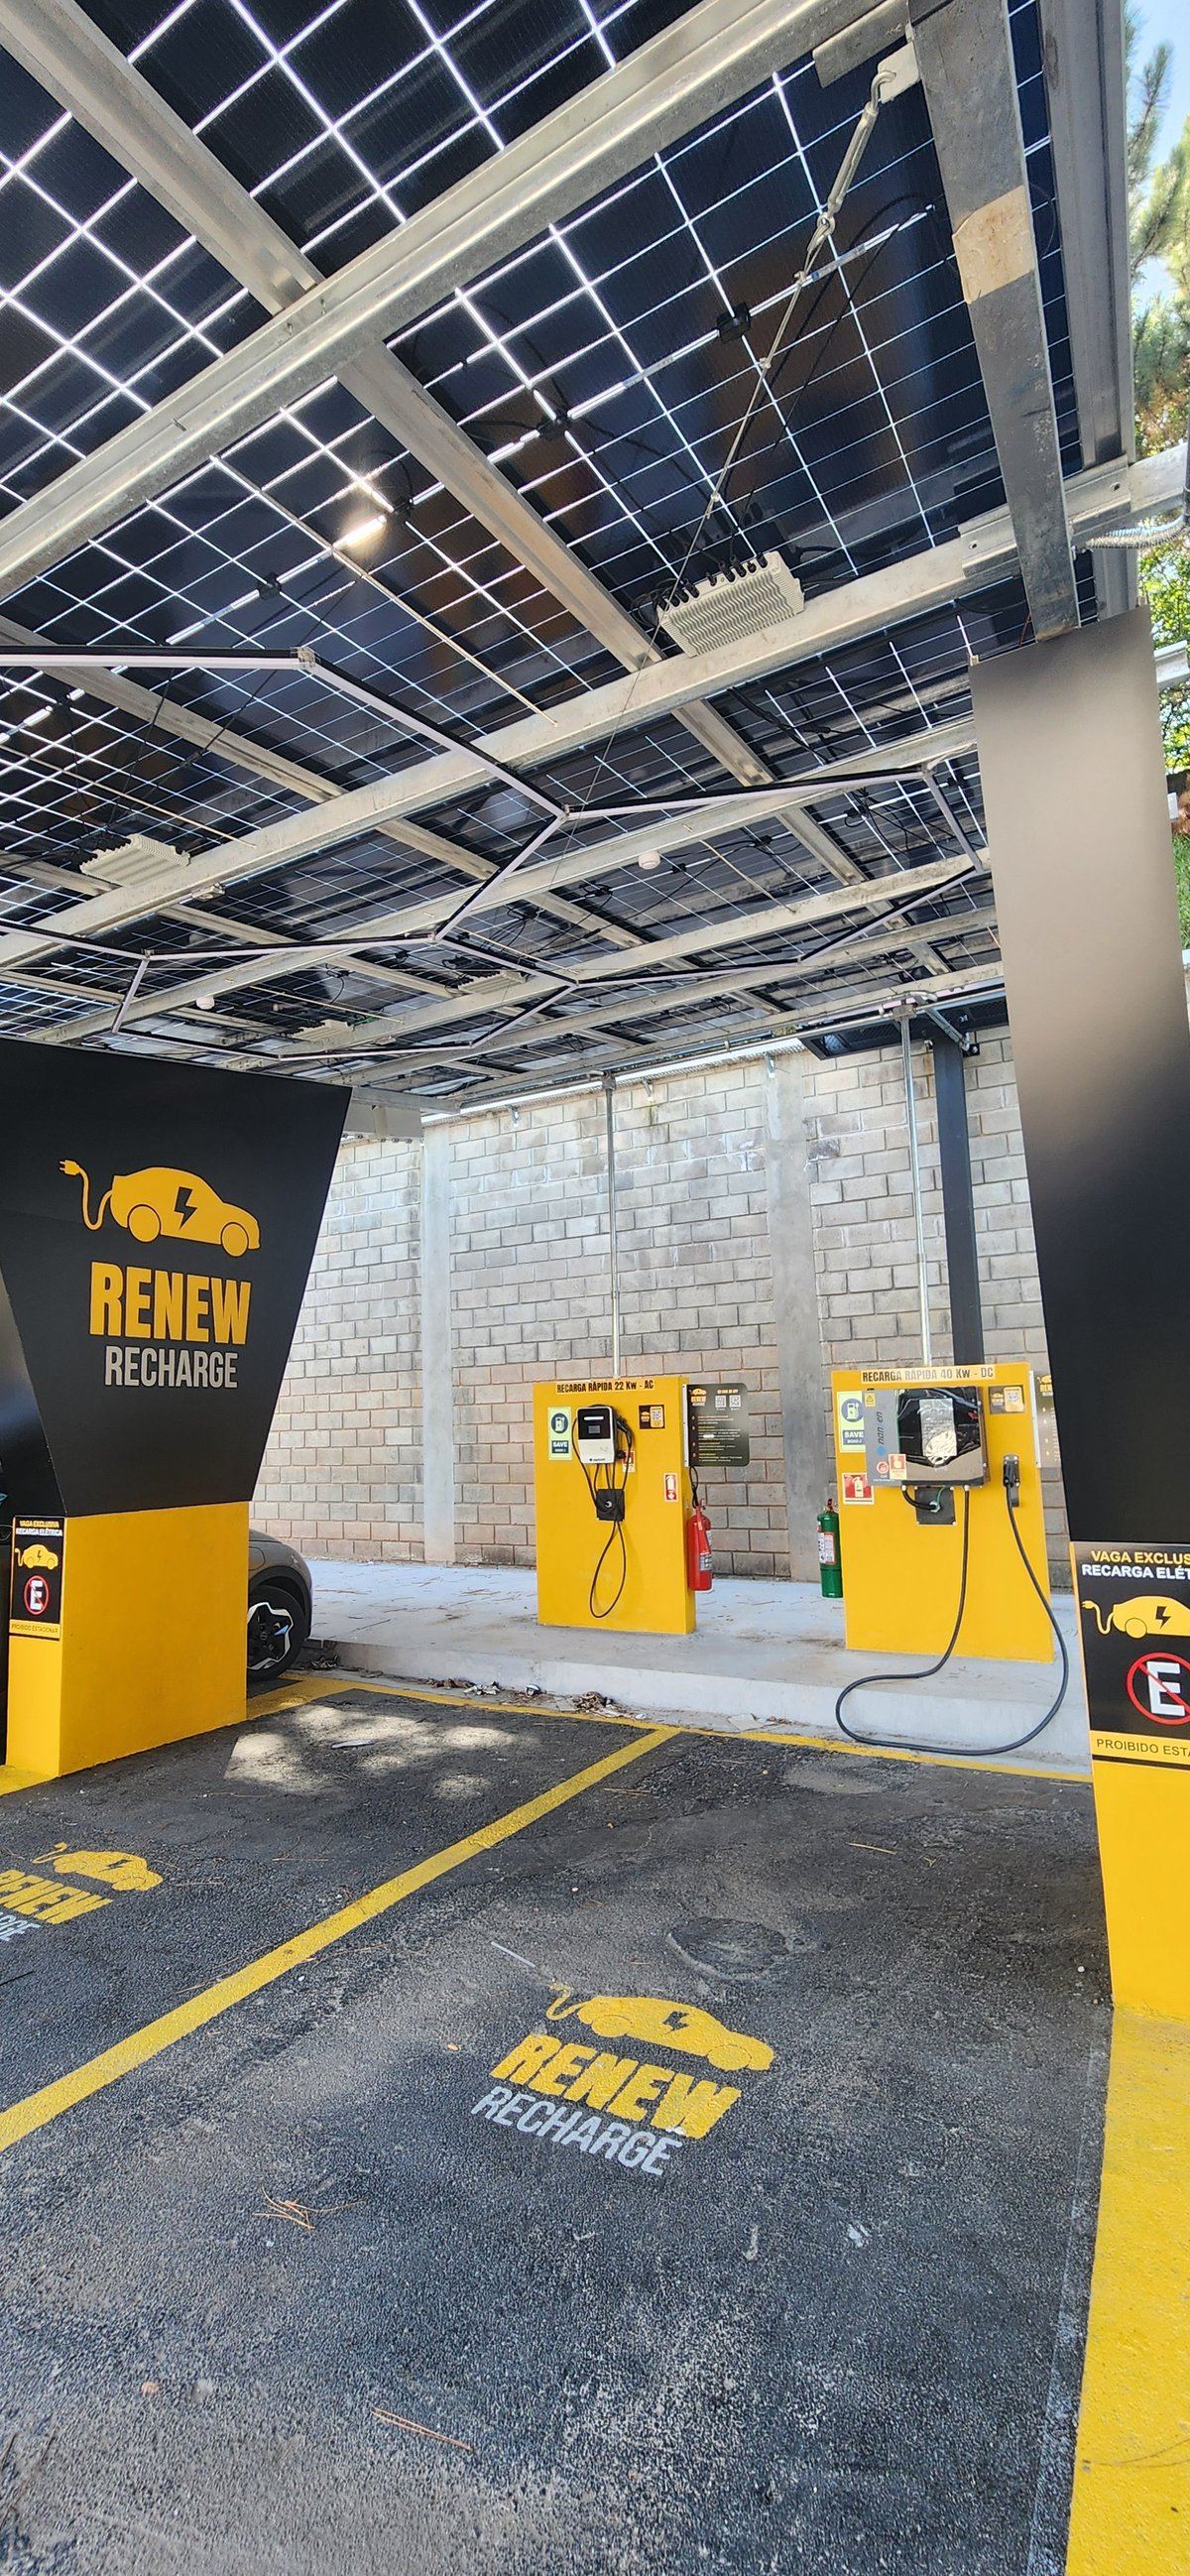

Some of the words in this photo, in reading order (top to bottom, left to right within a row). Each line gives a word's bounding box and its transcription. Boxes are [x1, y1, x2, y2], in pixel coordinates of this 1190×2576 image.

[89, 1261, 251, 1345] RENEW
[105, 1345, 238, 1389] RECHARGE
[863, 1371, 901, 1382] RECARGA
[904, 1368, 937, 1381] RÁPIDA
[940, 1369, 953, 1379] 40
[981, 1368, 994, 1378] DC
[557, 1383, 586, 1393] RECARGA
[588, 1381, 613, 1392] RÁPIDA
[615, 1381, 624, 1390] 22
[644, 1380, 654, 1389] AC
[1081, 1564, 1154, 1578] RECARGA
[1091, 1550, 1131, 1562] VAGA
[1146, 1660, 1185, 1717] E
[1096, 1738, 1159, 1754] PROIBIDO
[491, 2032, 742, 2140] RENEW
[471, 2086, 682, 2176] RECHARGE
